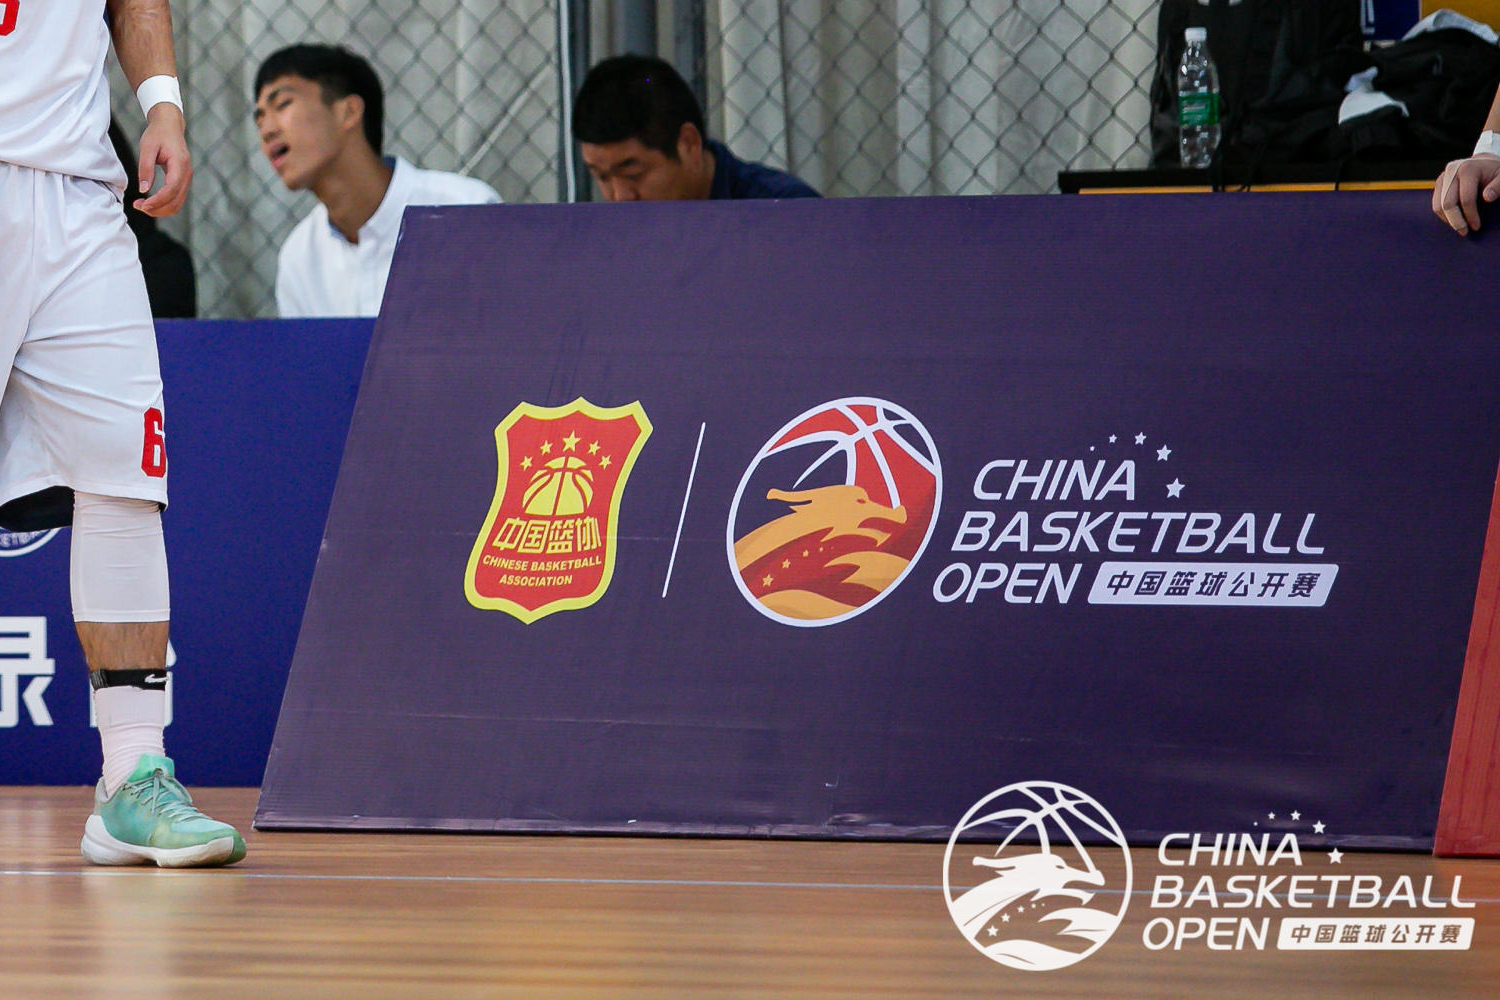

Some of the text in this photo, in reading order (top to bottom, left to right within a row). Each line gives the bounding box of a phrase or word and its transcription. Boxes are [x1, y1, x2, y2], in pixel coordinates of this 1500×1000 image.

[142, 408, 167, 478] 6
[973, 459, 1136, 501] CHINA
[492, 516, 602, 554] 中国篮协
[951, 511, 1325, 554] BASKETBALL
[482, 554, 602, 572] CHINESE BASKETBALL
[499, 574, 573, 587] ASSOCIATION
[932, 563, 1321, 604] OPEN 中国篮球公开赛
